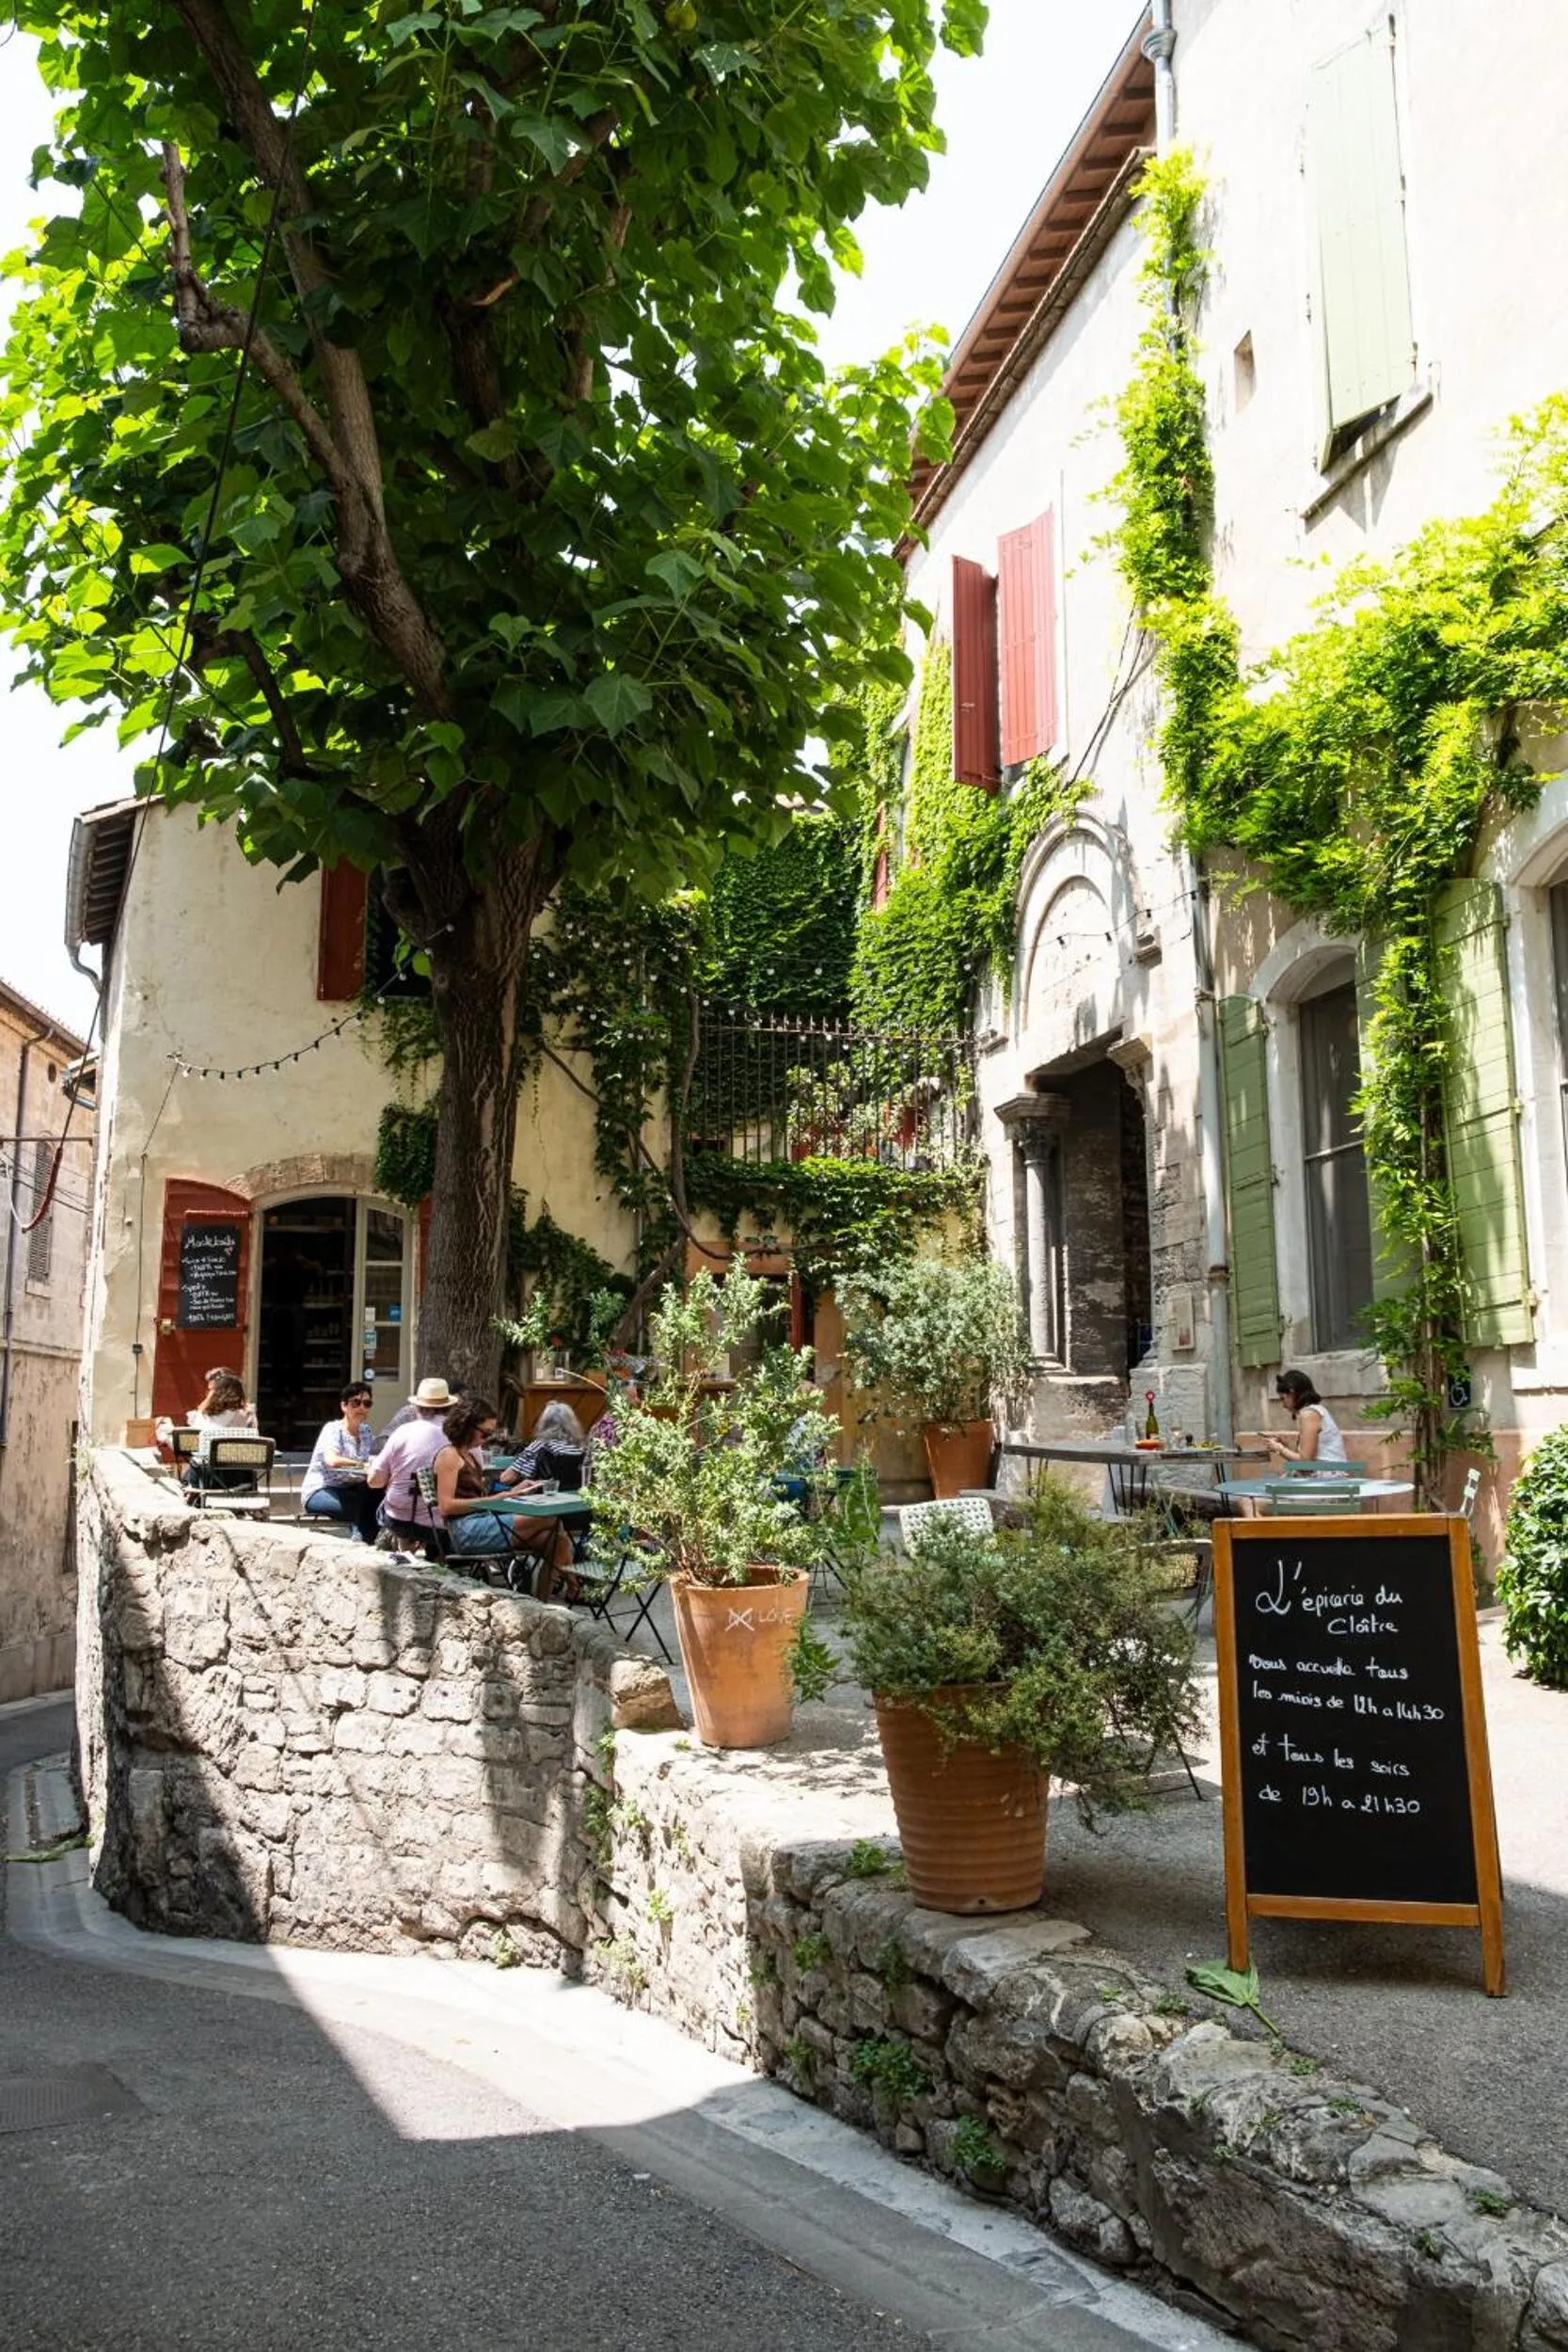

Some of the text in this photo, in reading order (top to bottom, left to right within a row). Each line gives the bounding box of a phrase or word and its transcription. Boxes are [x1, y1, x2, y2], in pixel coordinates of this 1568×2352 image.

[1375, 1585, 1402, 1605] du
[1327, 1613, 1398, 1634] Cloître
[1366, 1657, 1408, 1679] tous
[1254, 1680, 1272, 1699] les
[1326, 1695, 1343, 1708] de
[1252, 1733, 1410, 1775] et tous les soirs
[1259, 1785, 1281, 1801] de
[1303, 1786, 1332, 1806] 19h
